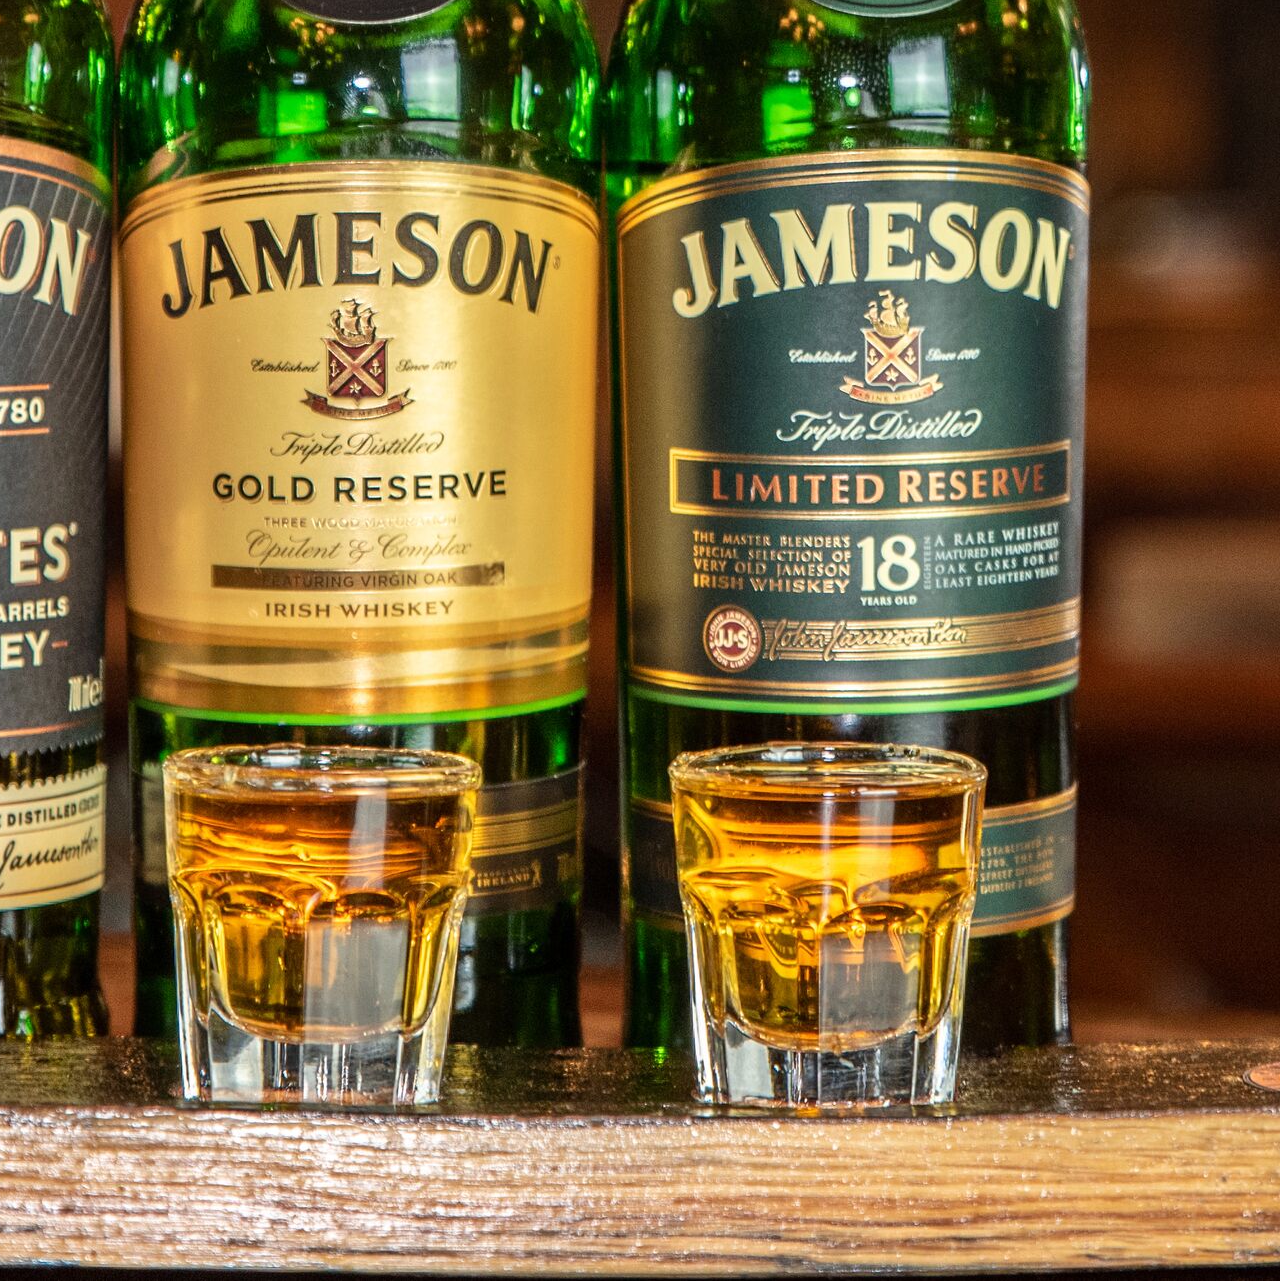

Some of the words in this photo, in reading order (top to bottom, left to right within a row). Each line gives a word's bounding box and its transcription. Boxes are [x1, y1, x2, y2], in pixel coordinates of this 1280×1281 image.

[161, 211, 553, 318] JAMESON
[672, 201, 1071, 318] JAMESON
[250, 358, 320, 373] Established
[395, 358, 429, 373] Since
[788, 349, 858, 364] Established
[776, 410, 866, 451] Triple
[867, 409, 983, 441] Distilled
[270, 431, 342, 465] Triple
[344, 431, 445, 458] Distilled
[212, 473, 316, 504] GOLD
[333, 469, 508, 504] RESERVE
[712, 468, 885, 505] LIMITED
[898, 463, 1045, 503] RESERVE
[264, 517, 307, 529] THREE
[312, 517, 360, 529] WOOD
[934, 534, 945, 547] A
[953, 530, 995, 547] RARE
[1001, 521, 1060, 542] WHISKEY
[245, 530, 342, 566] Opulent
[349, 539, 375, 565] &
[377, 533, 472, 565] Complex
[693, 529, 715, 543] THE
[722, 533, 771, 547] MASTER
[693, 544, 738, 559] SPECIAL
[748, 549, 824, 563] SELECTION
[831, 550, 852, 563] OF
[856, 534, 921, 592] 18
[923, 535, 932, 590] EIGHTEEN
[934, 546, 989, 561] MATURED
[991, 544, 1003, 557] IN
[1005, 541, 1032, 556] HAND
[934, 563, 967, 576] OAK
[974, 558, 1018, 573] CASKS
[1023, 554, 1045, 568] FOR
[1048, 550, 1060, 562] AT
[262, 572, 355, 590] FEATURING
[361, 571, 418, 589] VIRGIN
[423, 570, 458, 587] OAK
[693, 558, 727, 572] VERY
[734, 561, 767, 575] OLD
[776, 563, 851, 577] JAMESON
[935, 576, 972, 590] LEAST
[977, 569, 1032, 586] EIGHTEEN
[1034, 565, 1060, 580] YEARS
[693, 573, 744, 590] IRISH
[749, 577, 850, 594] WHISKEY
[265, 601, 331, 619] IRISH
[339, 599, 456, 619] WHISKEY
[860, 596, 892, 607] YEARS
[894, 594, 917, 606] OLD
[7, 802, 78, 827] DISTILLED
